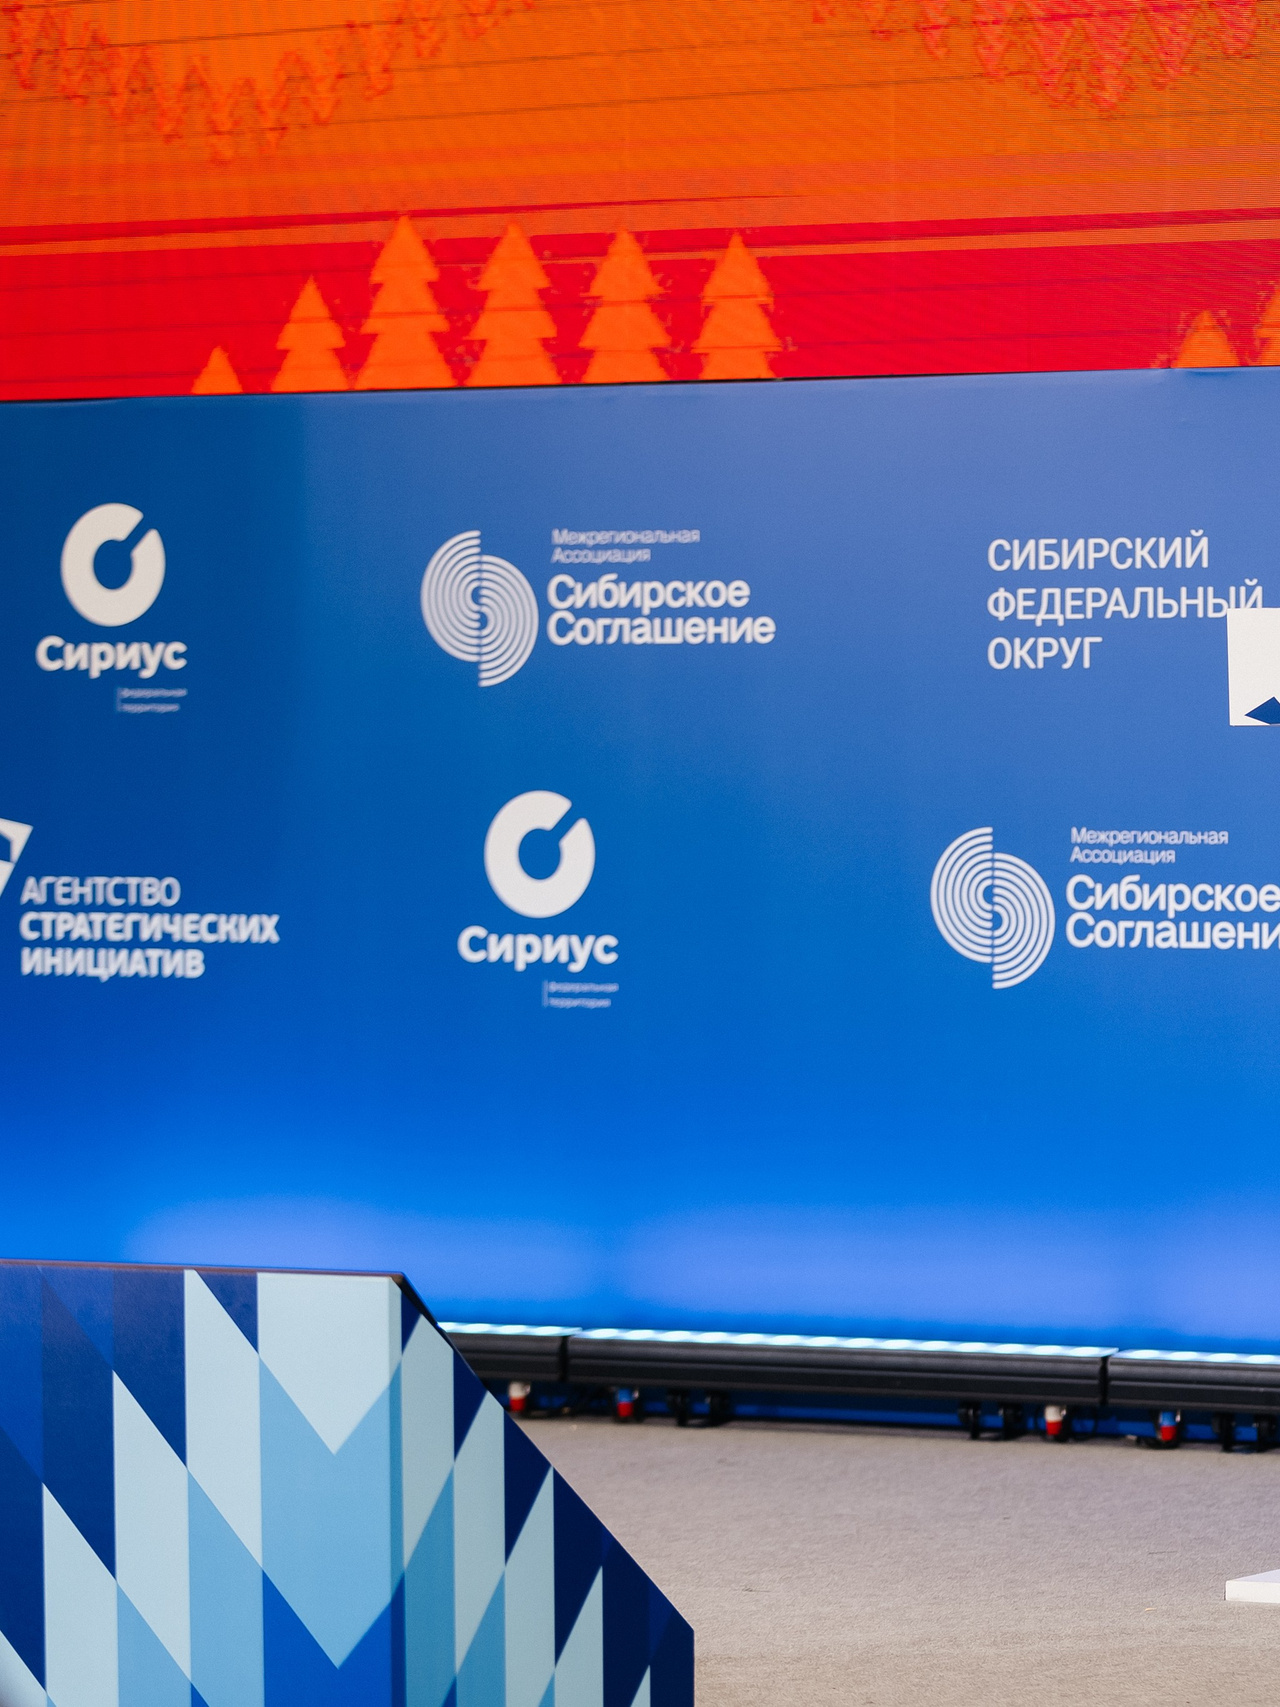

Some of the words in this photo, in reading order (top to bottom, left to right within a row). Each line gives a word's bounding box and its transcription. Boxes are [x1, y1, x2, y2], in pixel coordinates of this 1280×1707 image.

[552, 528, 701, 547] Межрегиональная
[988, 530, 1209, 571] СИБИРСКИЙ
[551, 547, 652, 565] Ассоциация
[547, 573, 751, 615] Сибирское
[988, 578, 1263, 626] ФЕДЕРАЛЬНЫЙ
[547, 609, 777, 646] Соглашение
[36, 635, 188, 679] Сириус
[988, 637, 1103, 671] ОКРУГ
[1070, 827, 1229, 848] Межрегиональная
[1070, 847, 1176, 866] Ассоциация
[20, 875, 181, 907] АГЕНТСТВО
[19, 911, 280, 944] СТРАТЕГИЧЕСКИХ
[20, 946, 206, 983] ИНИЦИАТИВ
[457, 925, 619, 973] Сириус
